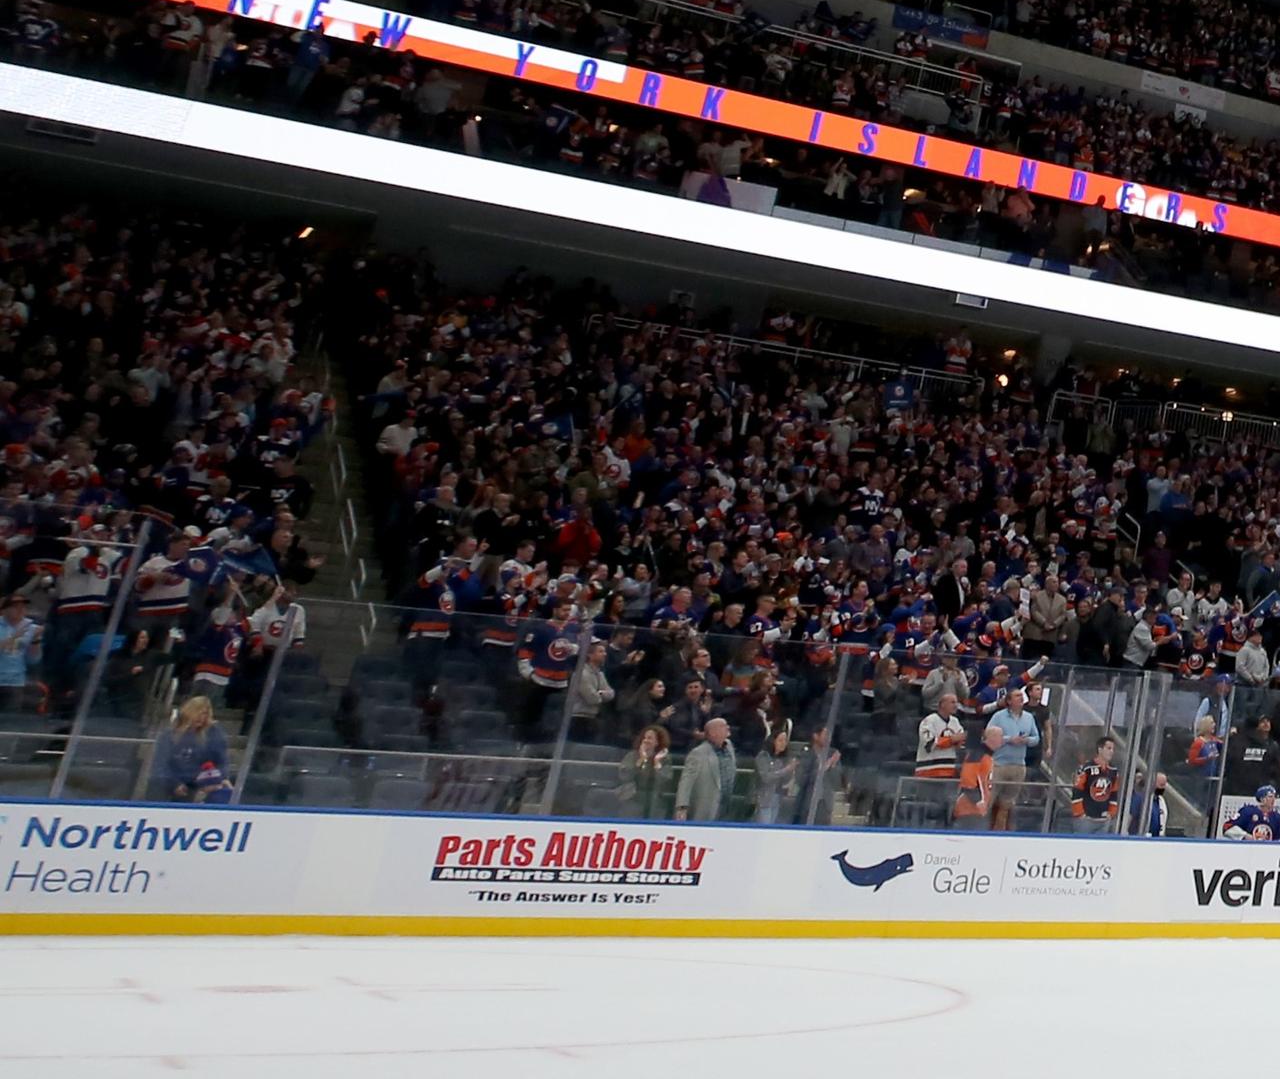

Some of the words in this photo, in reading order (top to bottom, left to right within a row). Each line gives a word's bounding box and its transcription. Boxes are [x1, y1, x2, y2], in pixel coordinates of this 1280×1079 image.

[514, 42, 727, 122] YORK
[808, 110, 1228, 233] ISLANDERS
[21, 816, 253, 852] Northwell
[435, 834, 537, 868] Parts
[540, 831, 706, 871] Authority
[924, 853, 961, 866] Daniel
[5, 860, 151, 894] Health
[439, 868, 492, 881] Auto
[495, 869, 555, 882] Parts
[558, 871, 623, 883] Super
[626, 872, 694, 885] Stores
[933, 867, 991, 895] Gale
[1014, 858, 1112, 885] Sotheby's
[516, 891, 587, 904] Answer
[591, 892, 608, 904] Is
[1011, 887, 1077, 897] INTERNATIONAL
